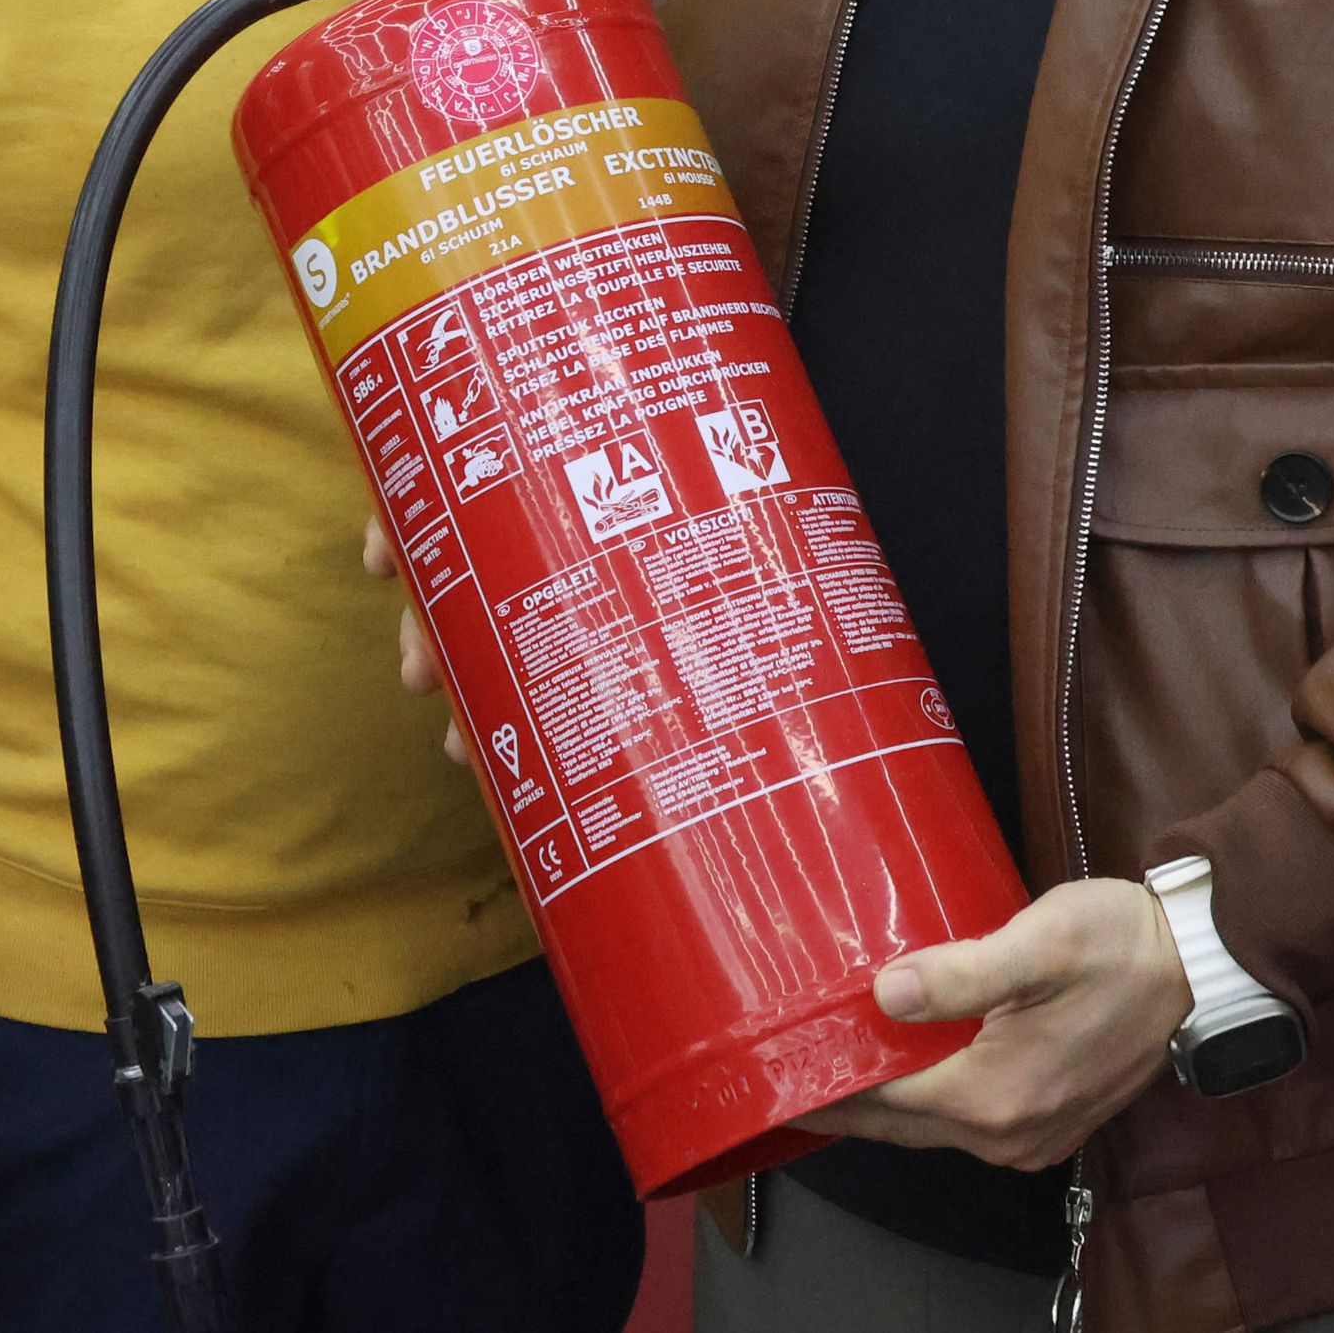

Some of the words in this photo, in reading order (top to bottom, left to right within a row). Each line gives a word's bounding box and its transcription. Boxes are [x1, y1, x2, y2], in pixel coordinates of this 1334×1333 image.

[419, 106, 643, 192] FEUERLÖSCHER
[520, 141, 588, 172] SCHAUM
[638, 194, 672, 208] 144B
[677, 172, 716, 186] MOUSSE
[349, 166, 575, 285] BRANDBLUSSER
[438, 218, 504, 257] SCHUIM
[489, 236, 523, 256] 21A
[472, 266, 551, 305] BORGPEN
[554, 232, 662, 270] WEGTREKKEN
[479, 258, 631, 322] SICHERUNGSSTIFT
[635, 243, 732, 268] HERAUSZIEHEN
[485, 304, 557, 339] RETIREZ
[560, 291, 582, 309] LA
[586, 272, 664, 299] GOUPILLE
[667, 264, 686, 279] DE
[688, 259, 742, 275] SECURITE
[496, 319, 592, 366] SPUITSTUK
[595, 296, 666, 328] RICHTEN
[503, 327, 635, 383] SCHLAUCHENDE
[638, 314, 668, 334] AUF
[672, 302, 749, 323] BRANDHERD
[353, 374, 382, 404] SB6.4
[509, 372, 560, 401] VISEZ
[563, 362, 586, 377] LA
[590, 344, 632, 368] BASE
[636, 334, 667, 354] DES
[669, 320, 734, 342] FLAMMES
[519, 376, 626, 428] KNIJPKRAAN
[630, 350, 722, 384] INDRUKKEN
[525, 414, 579, 446] HEBEL
[581, 385, 656, 422] KRÄFTIG
[659, 361, 770, 394] DURCHDRÜCKEN
[533, 426, 606, 463] PRESSEZ
[611, 414, 632, 431] LA
[635, 390, 707, 420] POIGNEE
[738, 408, 768, 441] B
[622, 443, 653, 479] A
[409, 525, 450, 561] PRODUCTION
[663, 506, 754, 545] VORSICHT!
[521, 564, 597, 611] OPGELET!
